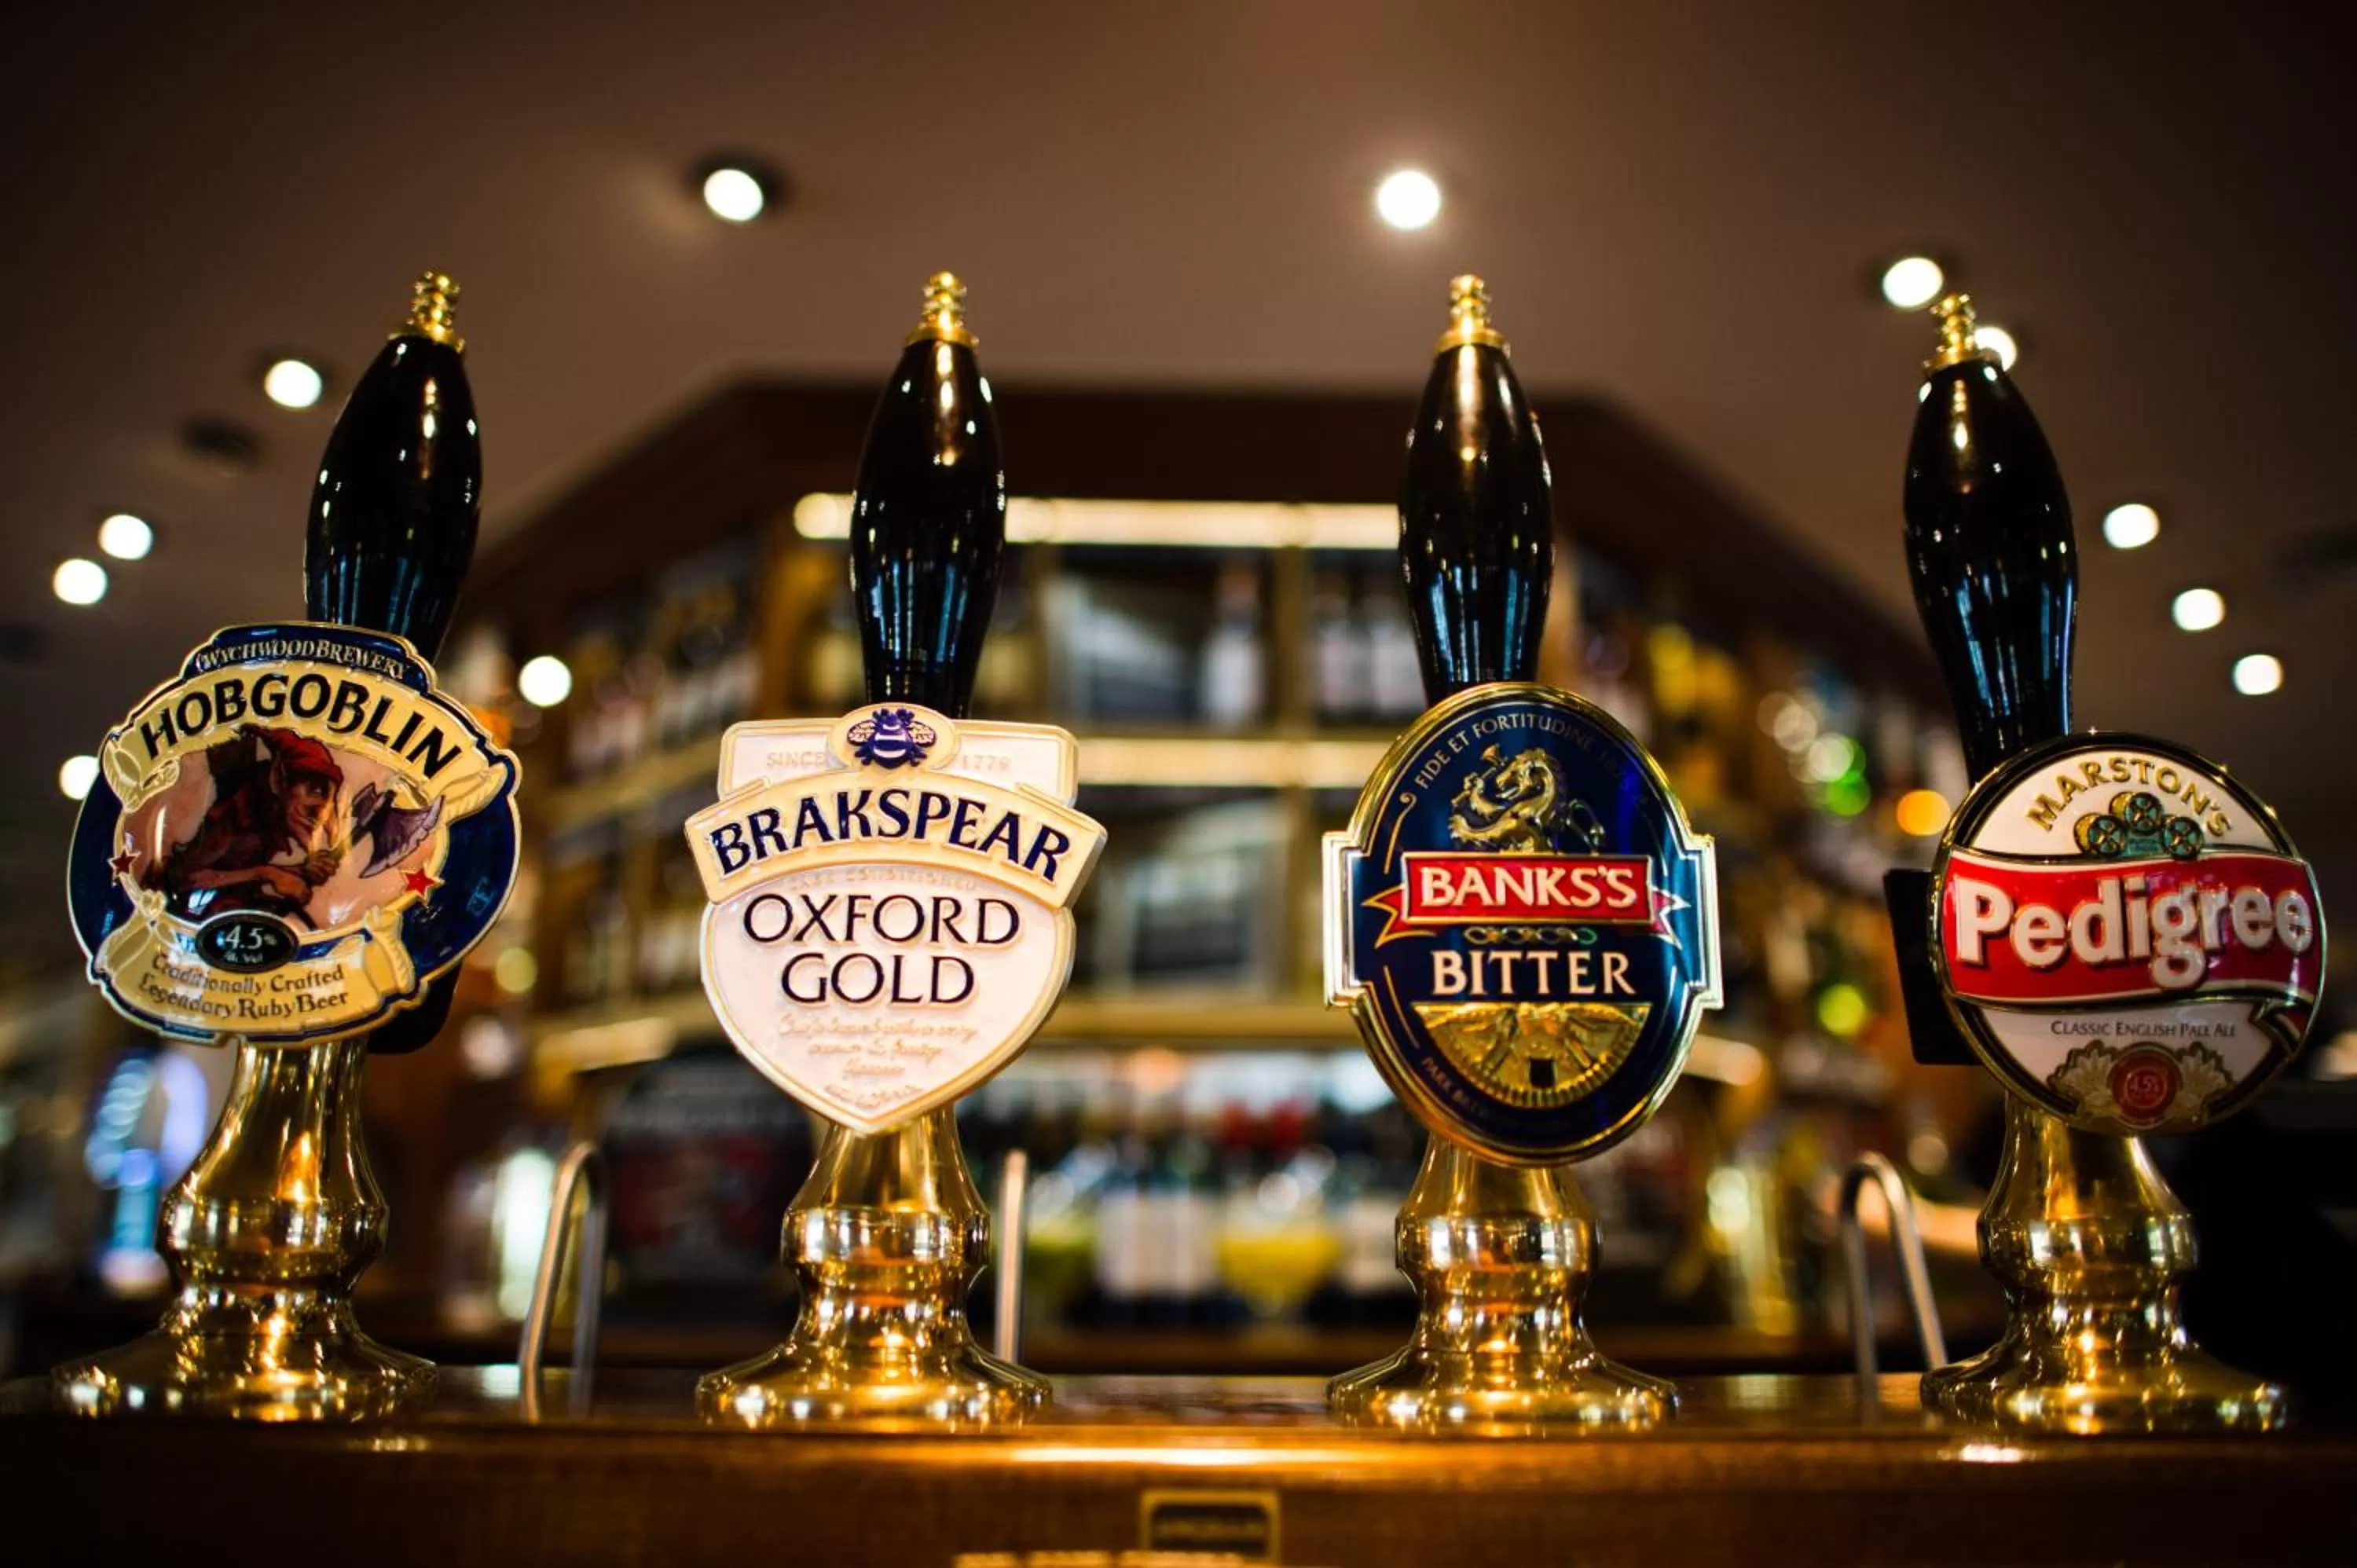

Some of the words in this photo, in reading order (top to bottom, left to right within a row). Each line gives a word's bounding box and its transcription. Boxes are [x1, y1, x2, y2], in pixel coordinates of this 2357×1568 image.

[197, 640, 313, 672] WYCHWOOD
[316, 639, 407, 680] BREWERY
[139, 672, 462, 780] HOBGOBLIN
[1414, 750, 1452, 790] FIDE
[1447, 731, 1472, 755] ET
[2027, 757, 2232, 838] MARSTON'S
[709, 788, 1071, 883] BRAKSPEAR
[1420, 866, 1637, 908] BANKS'S
[743, 893, 1020, 944] OXFORD
[1955, 874, 2312, 991] Pedigree
[138, 972, 233, 1019] Legendary
[237, 998, 294, 1019] Ruby
[295, 992, 348, 1013] Beer
[270, 965, 343, 992] Crafted
[780, 953, 974, 1004] GOLD
[1431, 951, 1637, 995] BITTER
[2051, 1020, 2111, 1035] CLASSIC
[2116, 1021, 2176, 1037] ENGLISH
